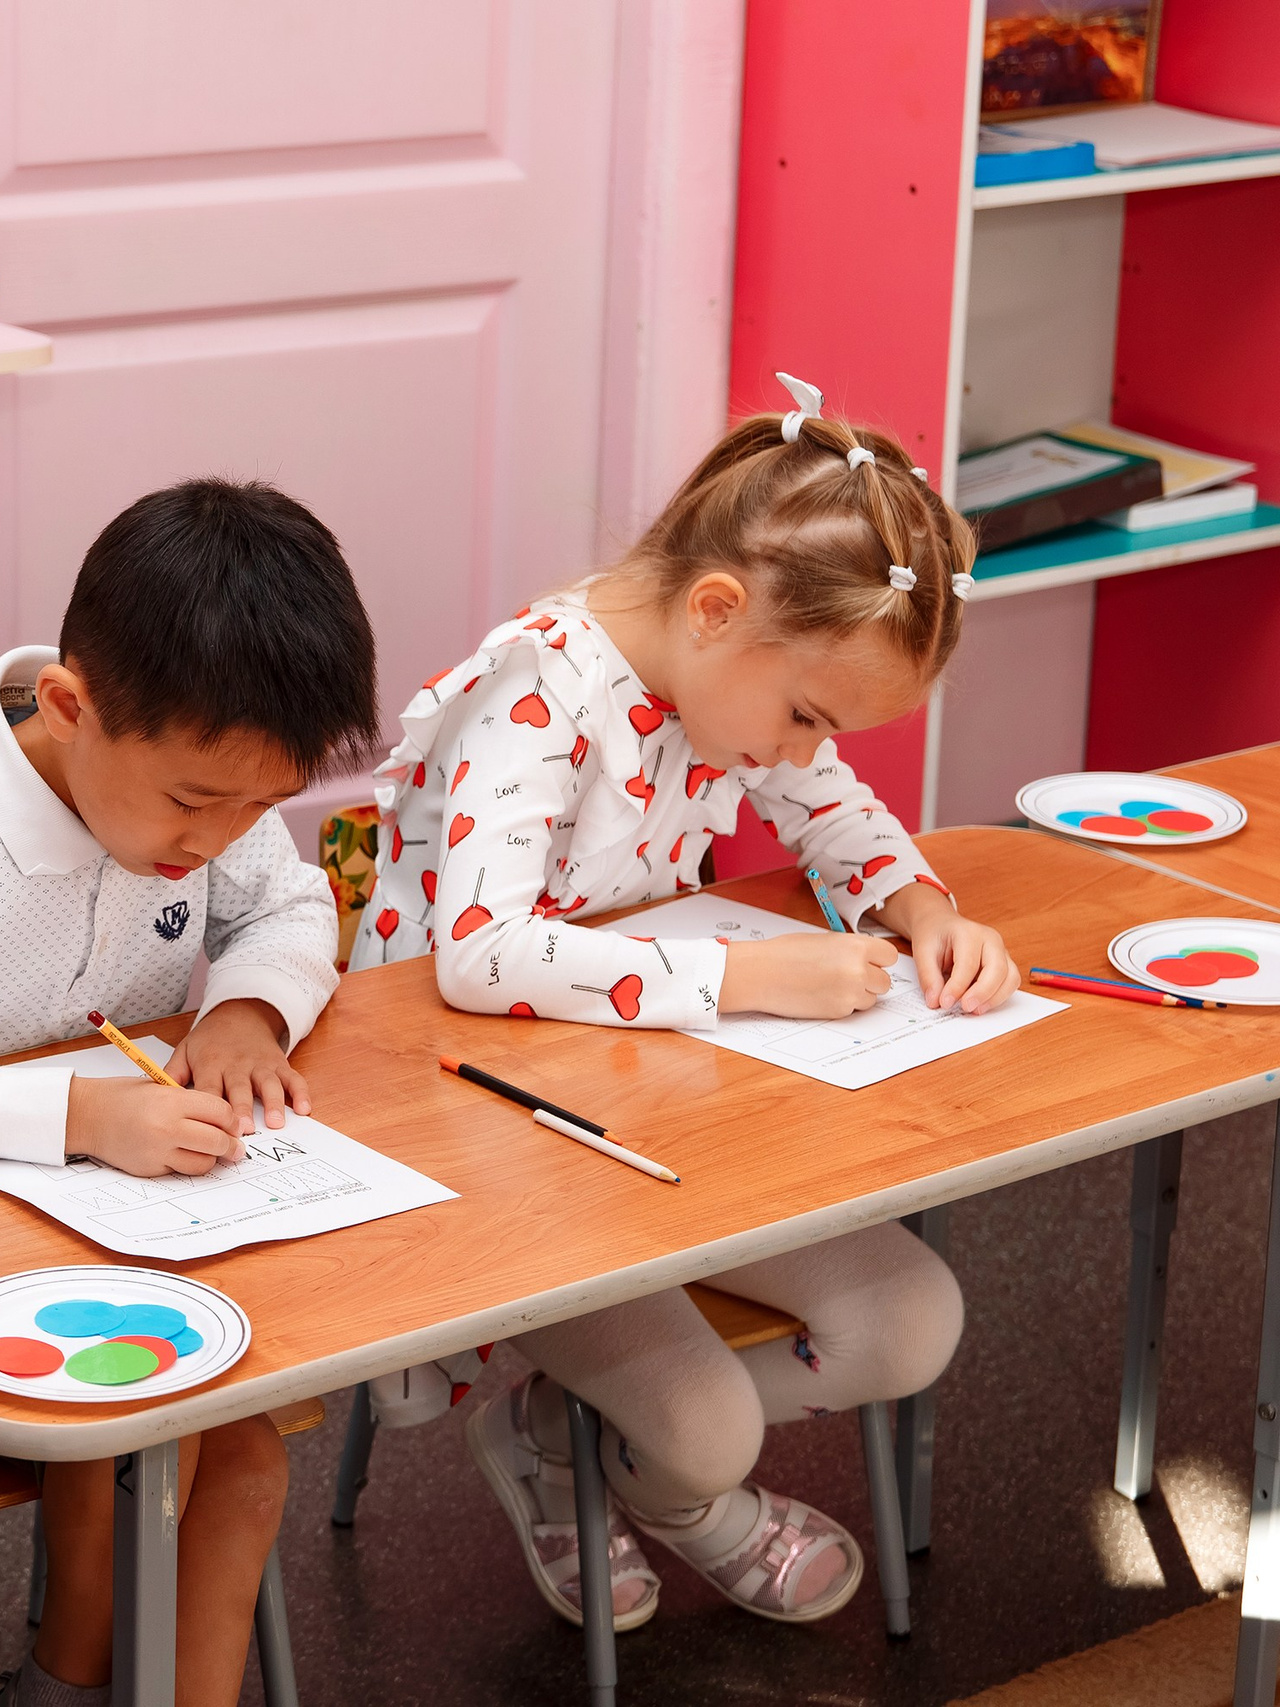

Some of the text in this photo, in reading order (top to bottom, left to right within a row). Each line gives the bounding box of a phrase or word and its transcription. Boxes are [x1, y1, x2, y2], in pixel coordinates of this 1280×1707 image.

[495, 784, 522, 799] LOVE
[507, 833, 533, 849] LOVE
[542, 933, 559, 963] LOVE
[488, 951, 501, 986] LOVE
[698, 984, 716, 1011] LOVE
